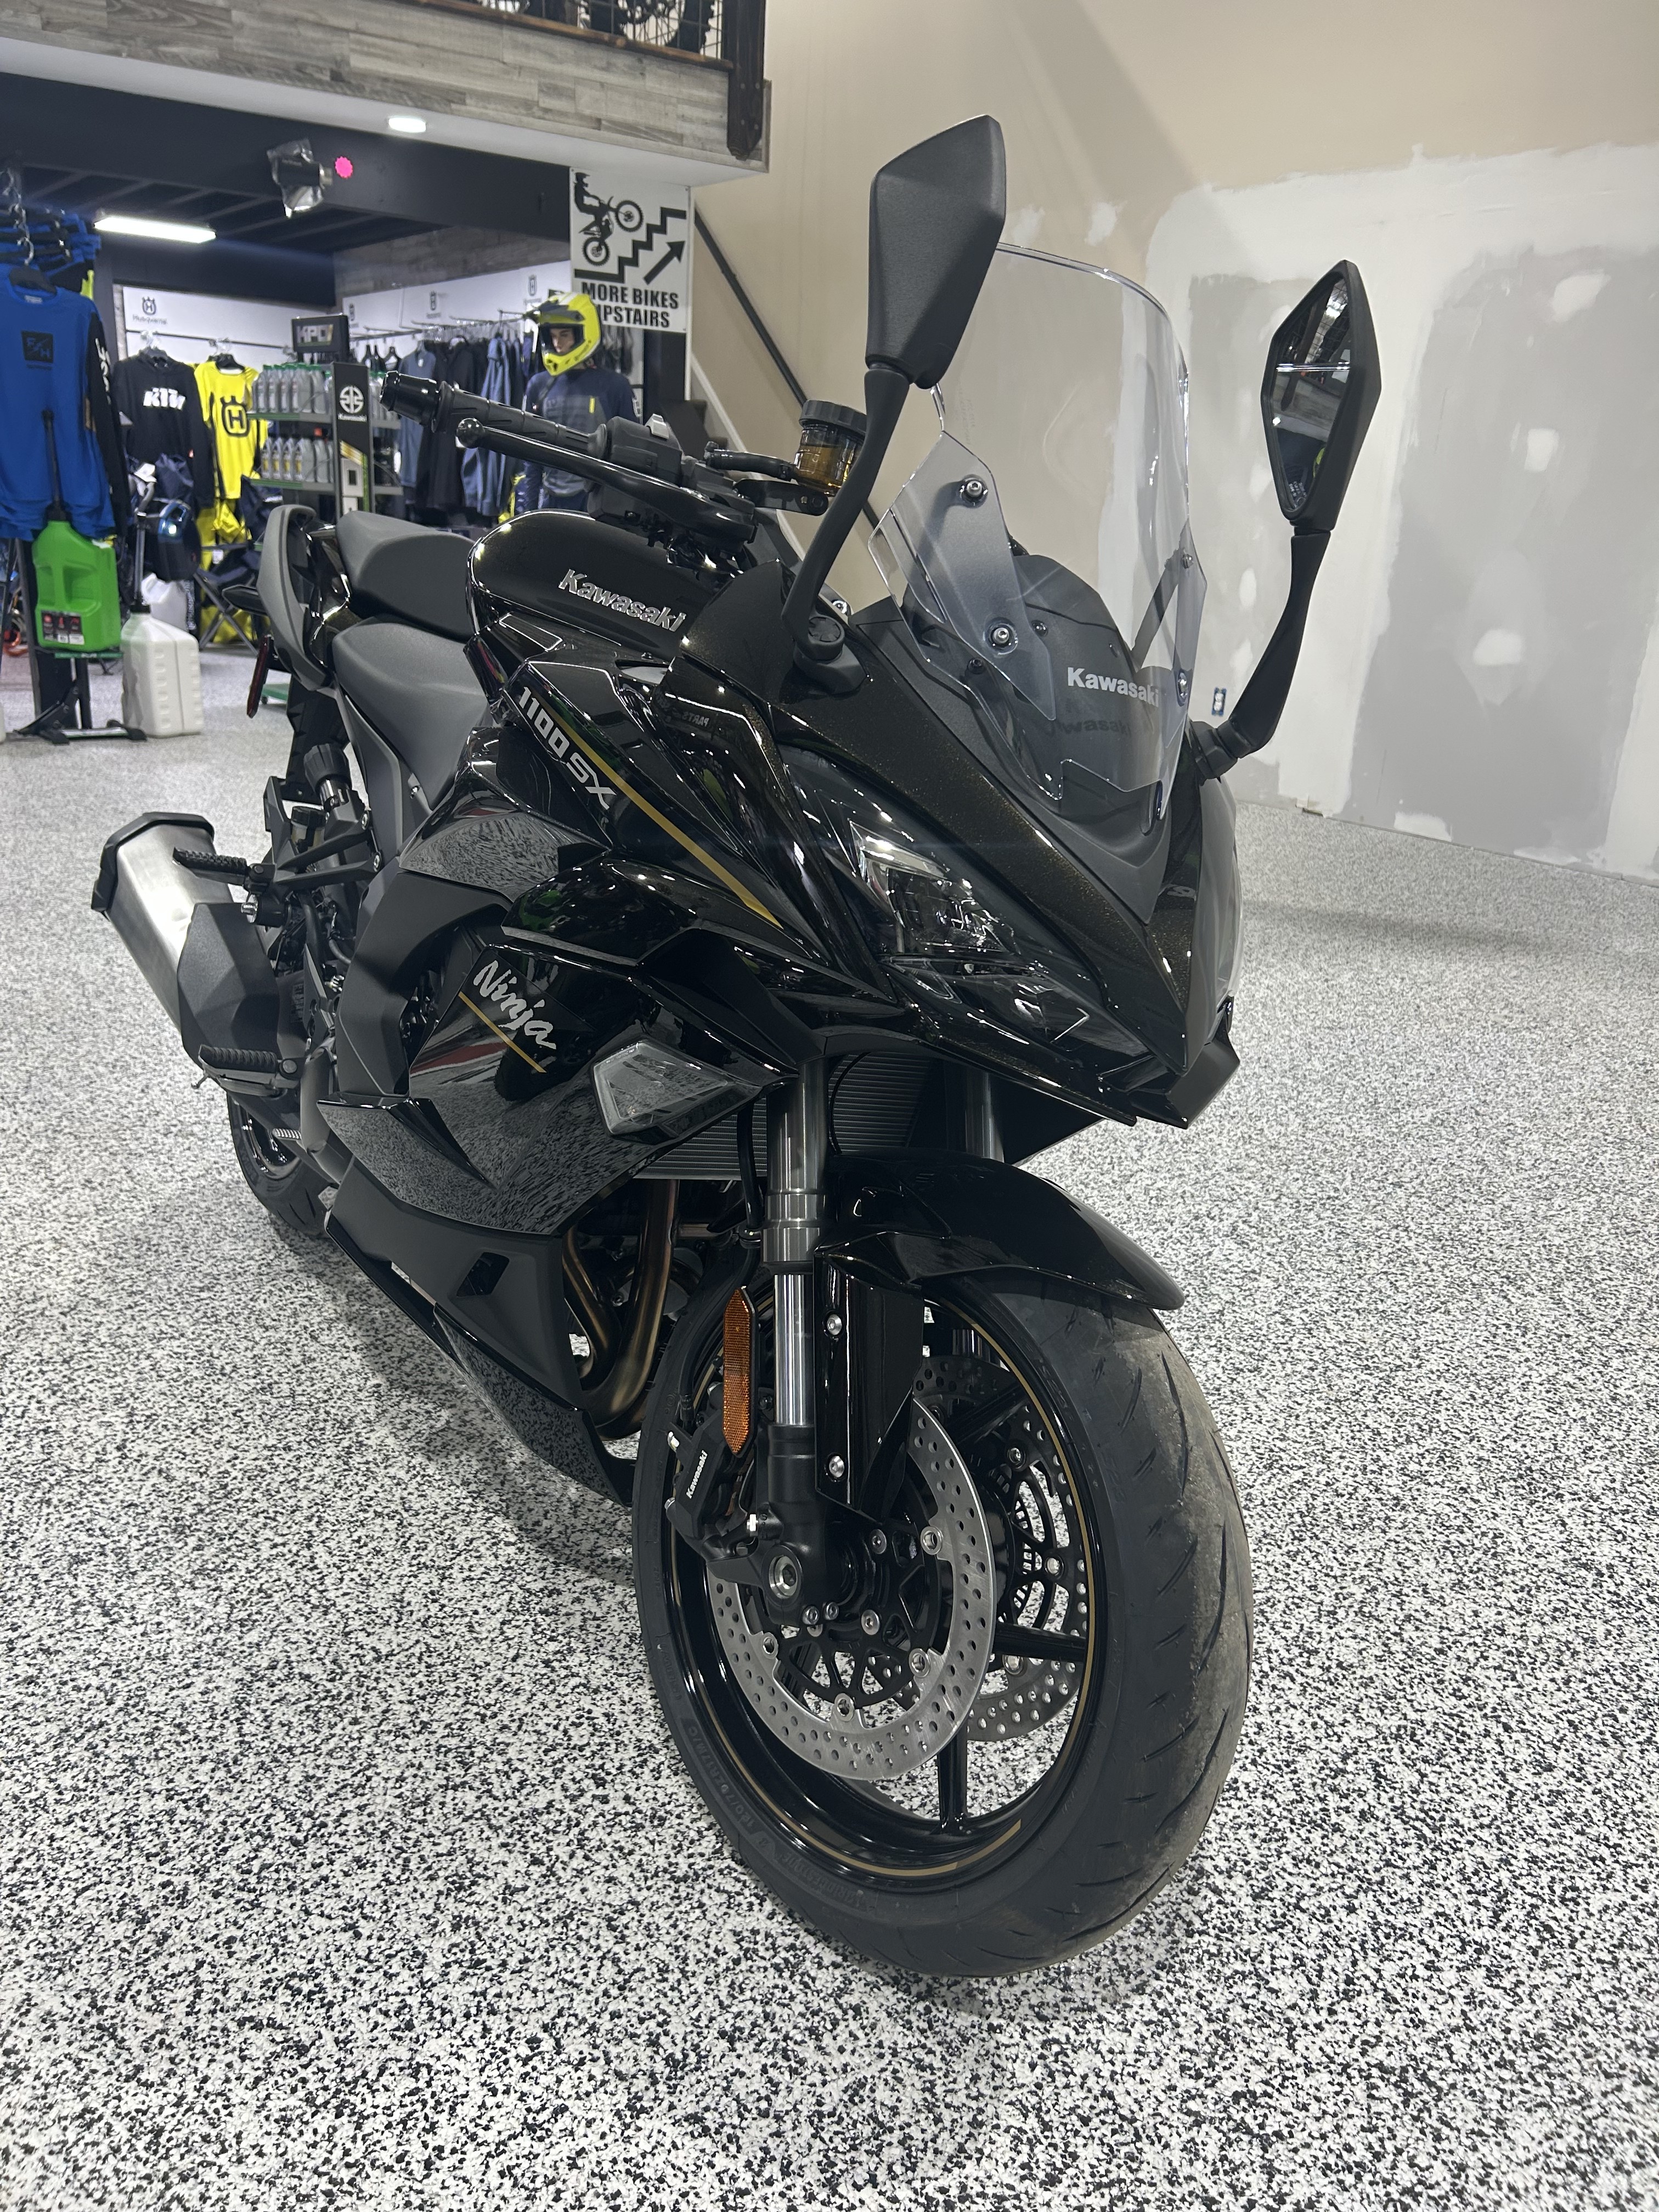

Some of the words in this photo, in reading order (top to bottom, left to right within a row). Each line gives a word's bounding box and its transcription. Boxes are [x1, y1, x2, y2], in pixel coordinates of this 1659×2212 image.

[582, 282, 628, 303] MORE
[633, 287, 679, 309] BIKES
[143, 387, 186, 410] KTM
[558, 568, 687, 632] Kawasaki
[1067, 667, 1159, 708] Kawasaki
[518, 686, 570, 759] 1100
[566, 752, 617, 810] SX
[473, 960, 557, 1049] Ninja
[686, 1449, 708, 1499] Kawasaki
